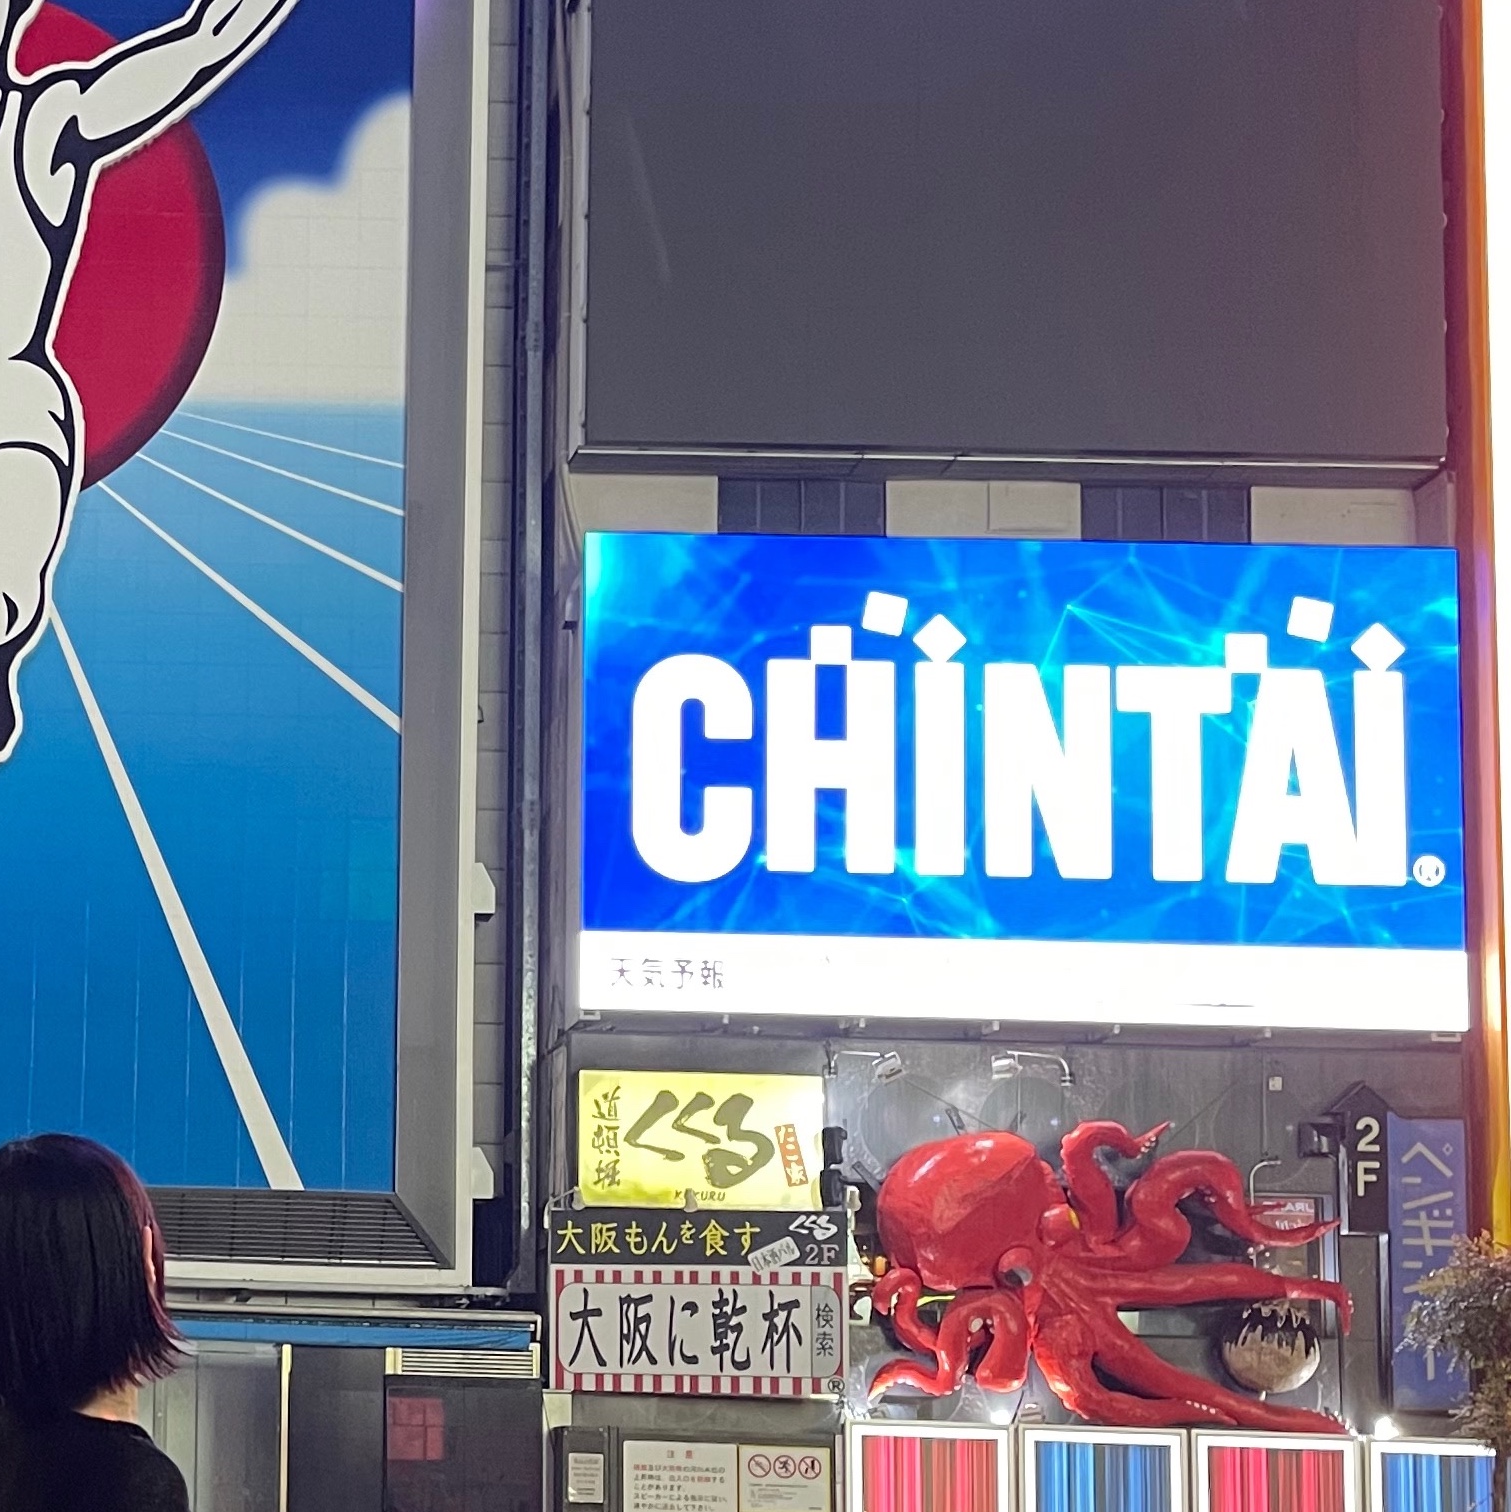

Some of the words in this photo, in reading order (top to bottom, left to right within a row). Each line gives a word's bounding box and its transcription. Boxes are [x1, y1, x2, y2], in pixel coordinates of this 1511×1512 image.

[610, 957, 724, 990] 天気予報
[623, 1089, 776, 1189] くくる
[674, 1189, 726, 1202] KKURU
[556, 1219, 761, 1257] 大阪もんを食す
[805, 1244, 839, 1265] 2F
[569, 1287, 803, 1374] 大阪に乾杯
[815, 1303, 834, 1358] 検索
